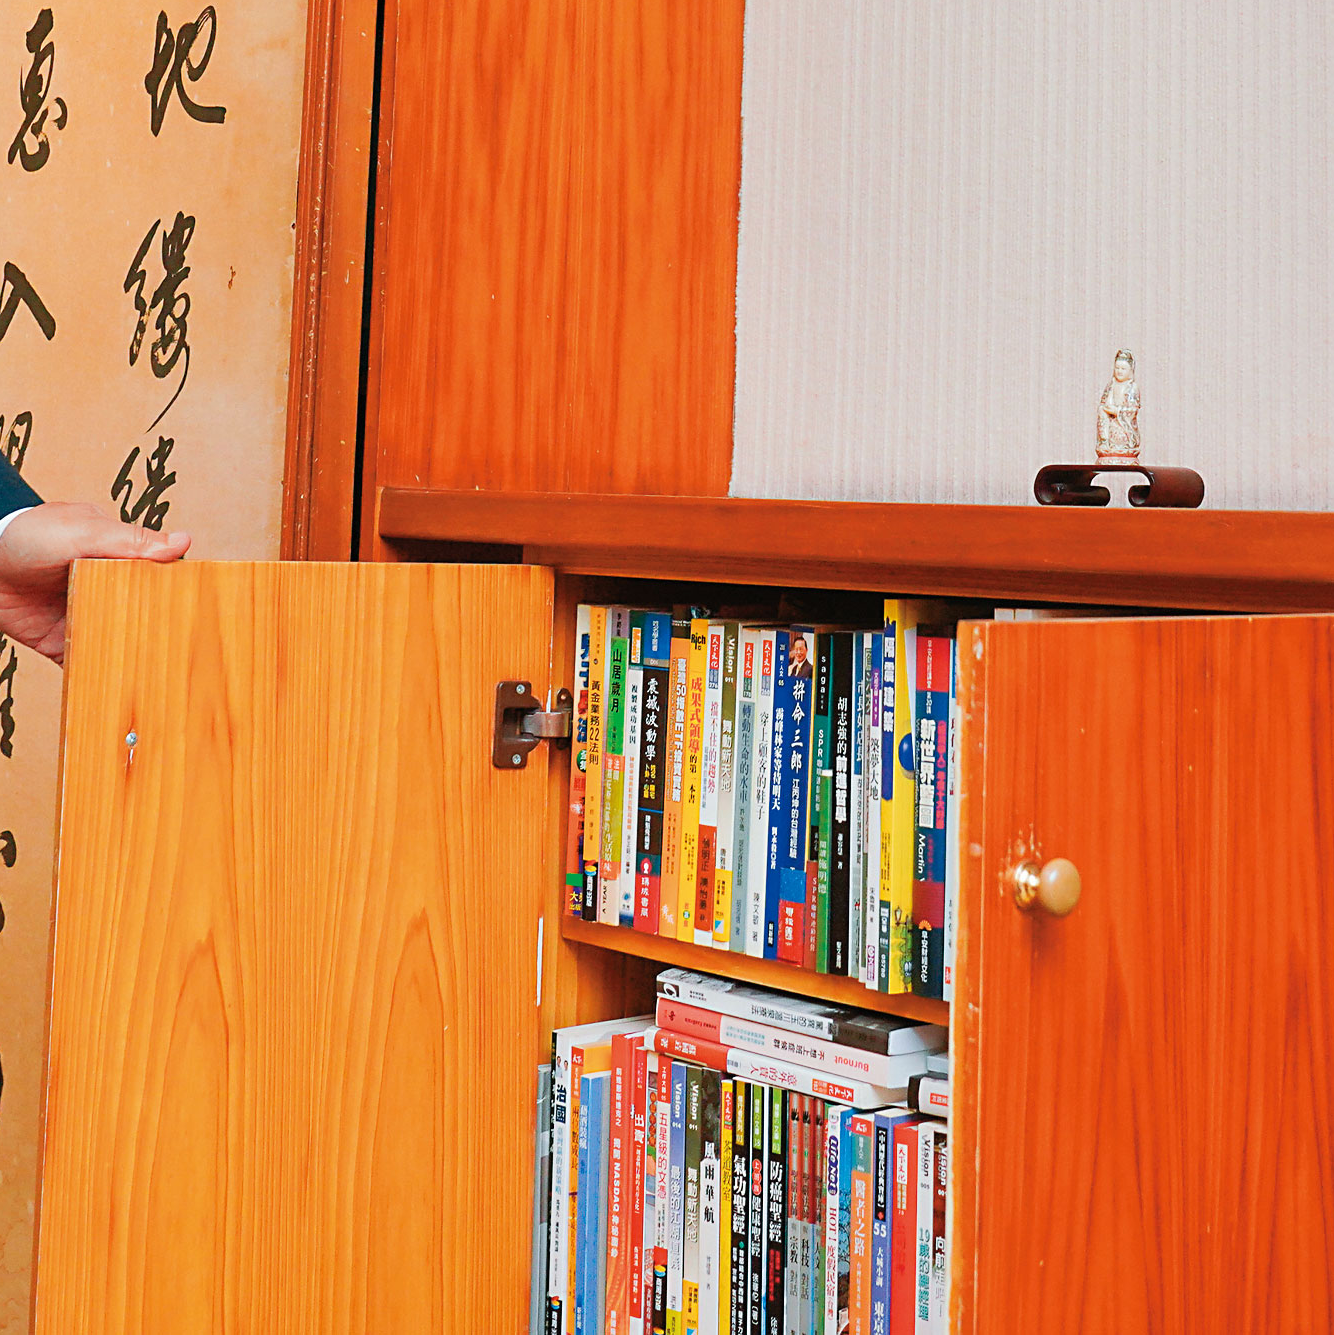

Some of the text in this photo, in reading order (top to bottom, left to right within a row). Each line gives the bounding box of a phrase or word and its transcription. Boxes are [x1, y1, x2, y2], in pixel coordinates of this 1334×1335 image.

[691, 633, 706, 650] Rich
[726, 637, 735, 673] Vision
[610, 648, 623, 713] 山居歲月
[588, 680, 601, 765] 黃金業務22法則
[917, 834, 926, 874] Martin
[834, 1056, 870, 1071] Burnout
[674, 1082, 683, 1118] Vision
[690, 1083, 699, 1120] Vision
[921, 1135, 931, 1177] Vision
[612, 1162, 621, 1212] NASDAQ
[732, 1155, 747, 1235] 氣功聖經
[769, 1160, 783, 1243] 防癌聖經
[873, 1223, 887, 1238] 55
